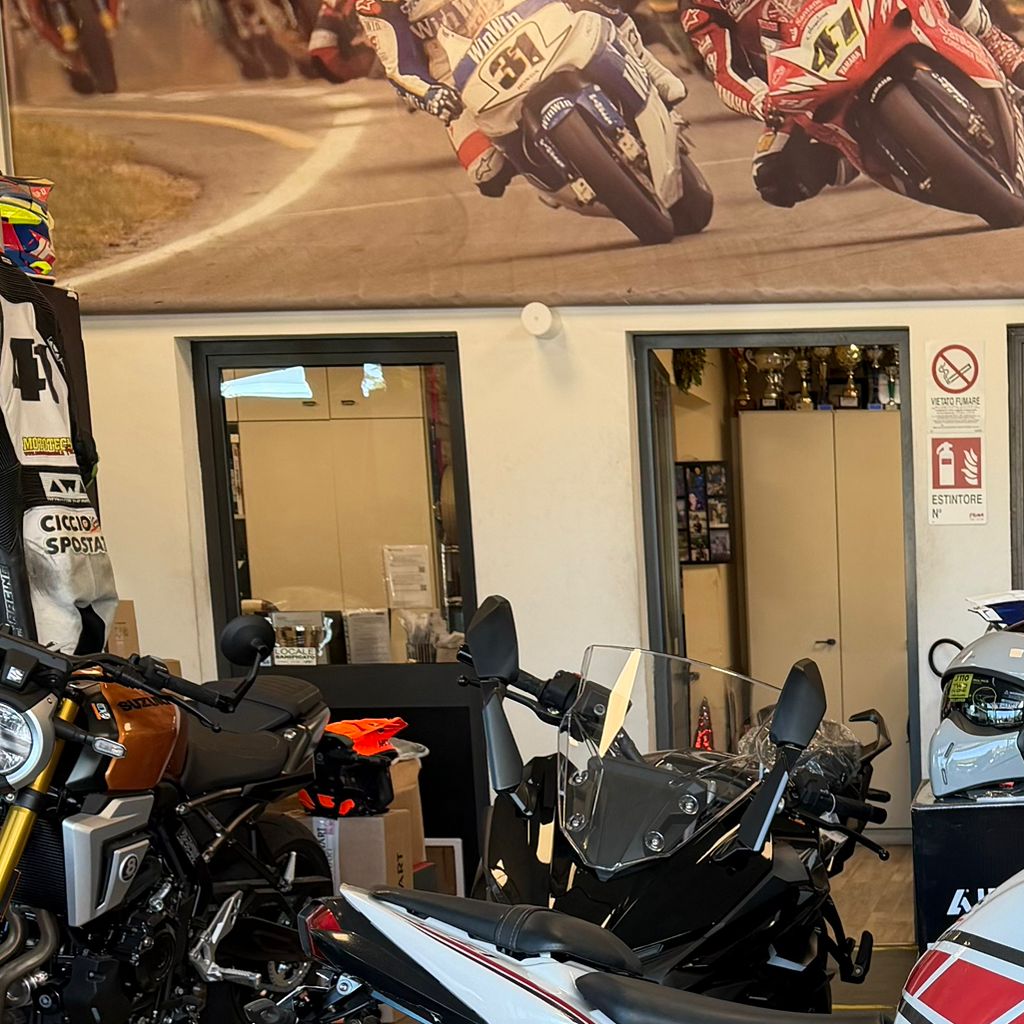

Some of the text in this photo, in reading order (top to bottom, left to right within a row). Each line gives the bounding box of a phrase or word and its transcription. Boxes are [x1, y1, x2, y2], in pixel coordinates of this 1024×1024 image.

[811, 6, 859, 73] 41
[930, 396, 981, 406] VIETATO FUMARE
[931, 494, 983, 506] ESTINTORE
